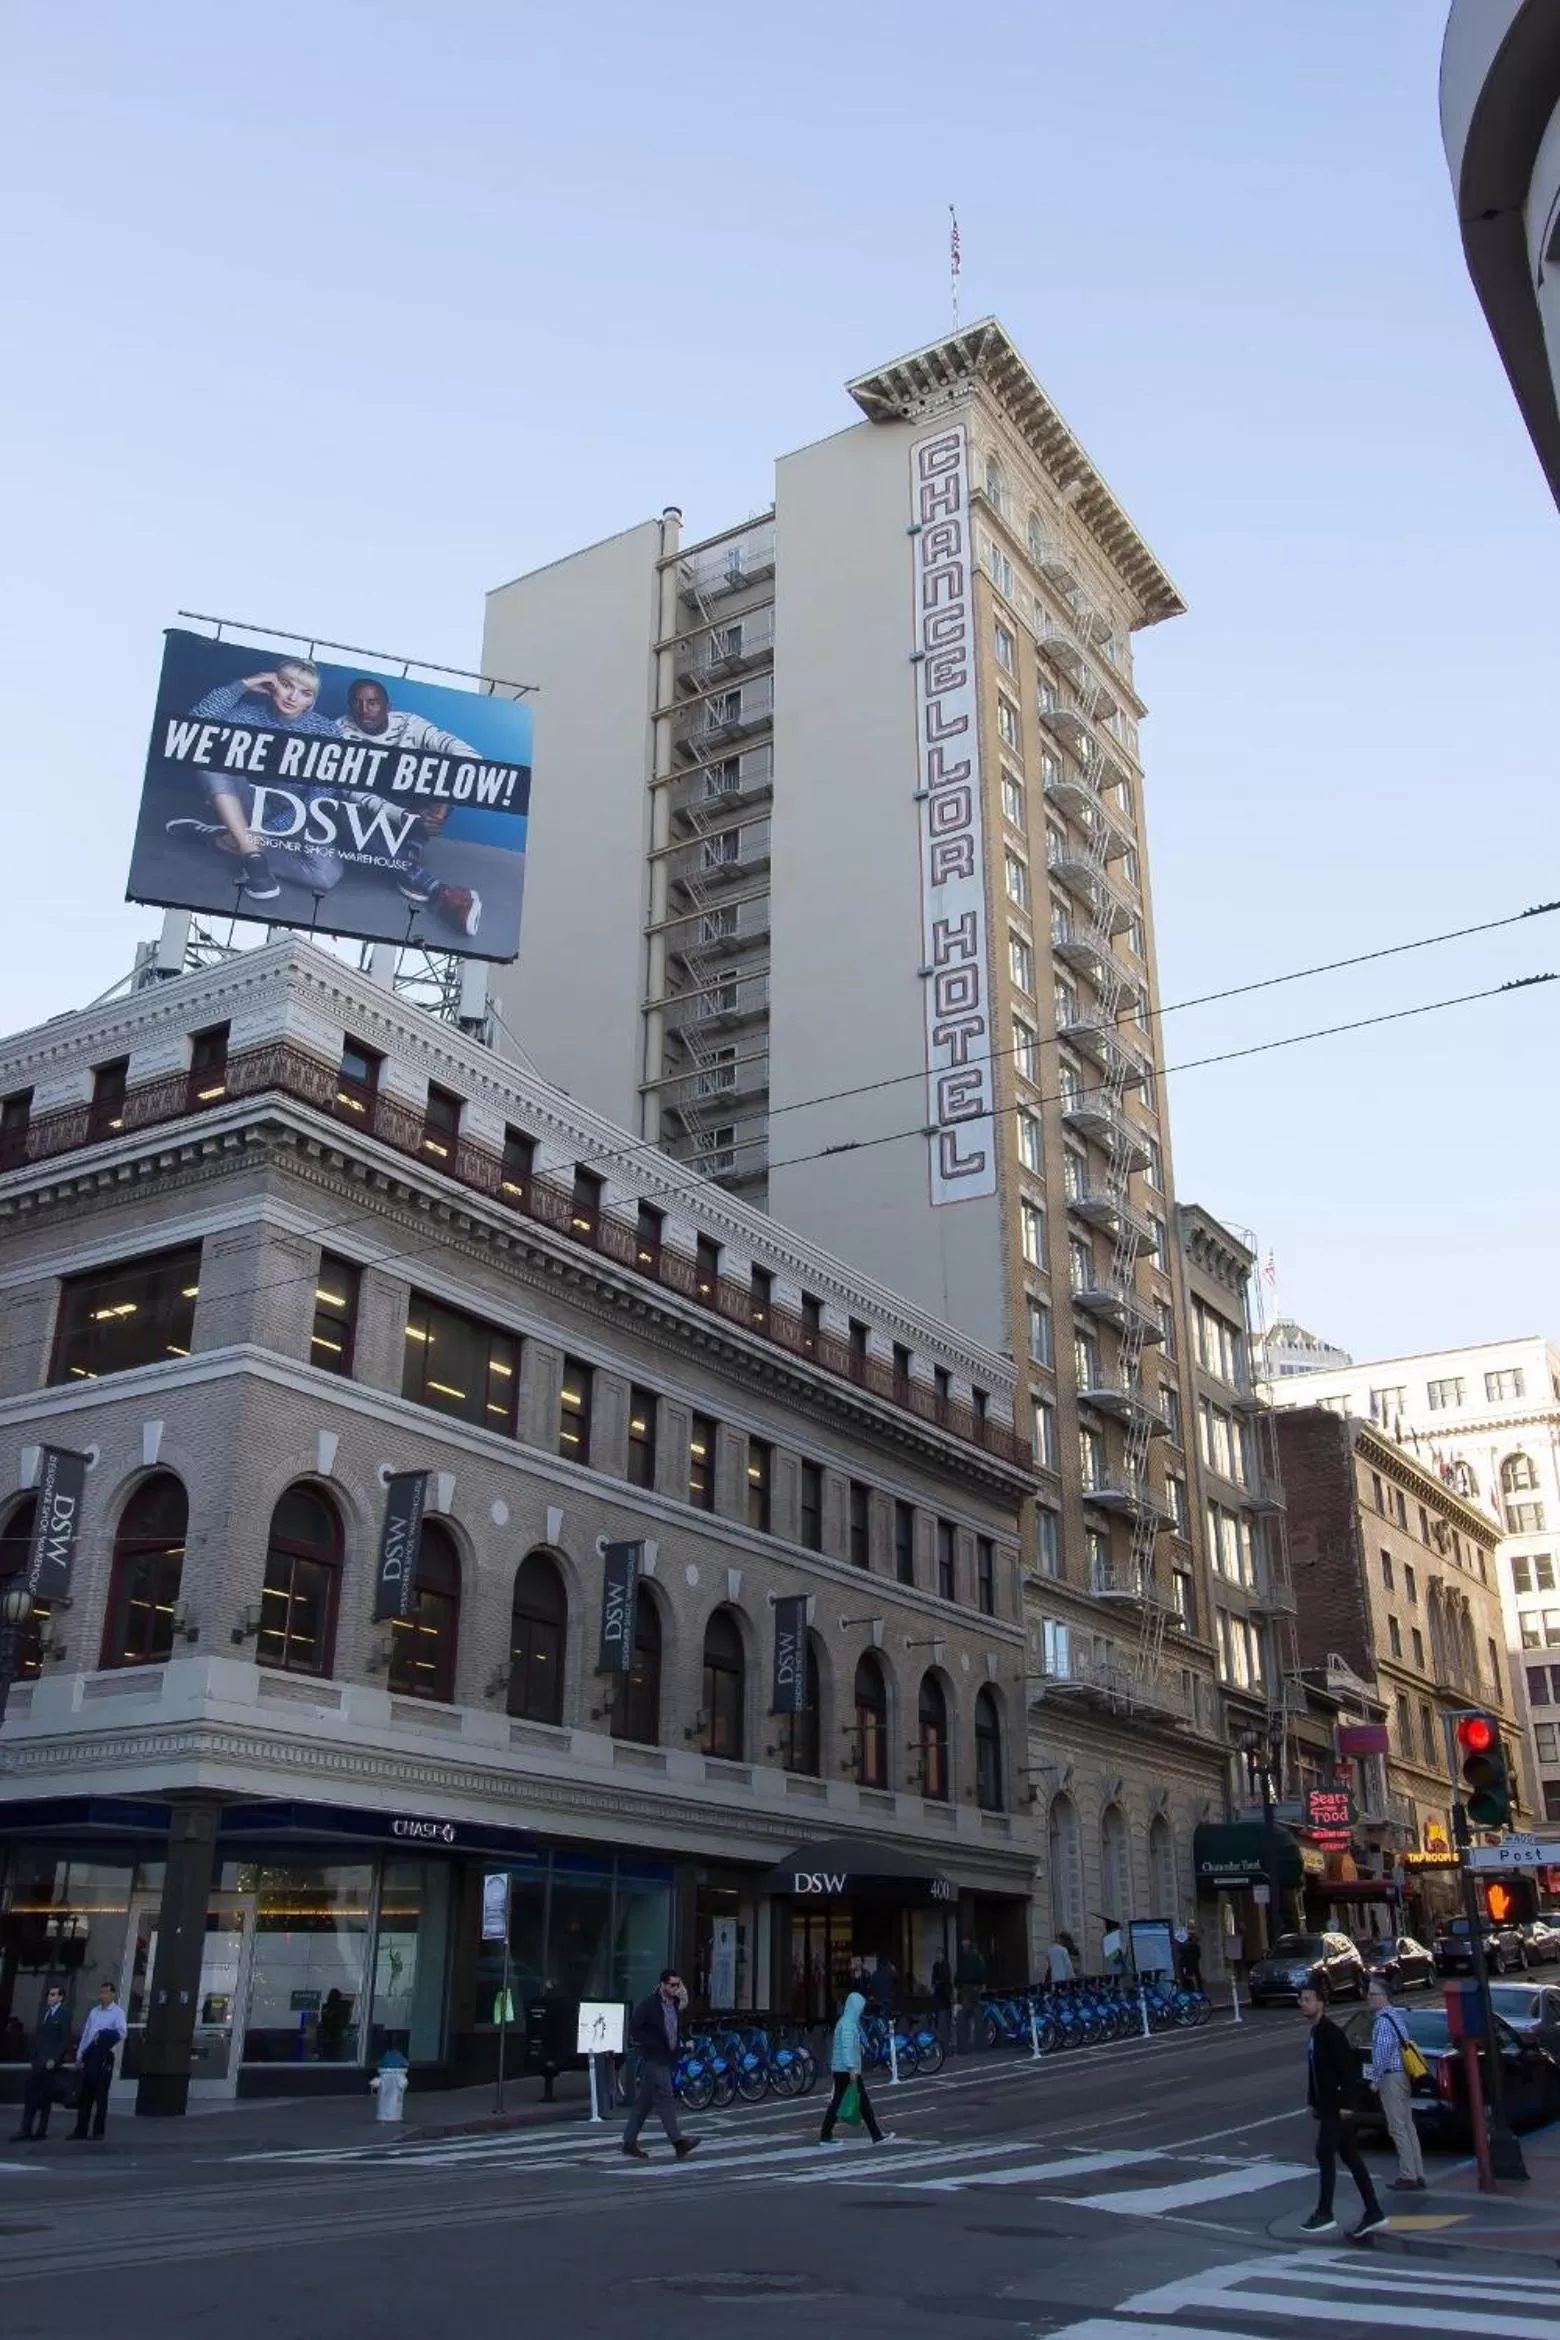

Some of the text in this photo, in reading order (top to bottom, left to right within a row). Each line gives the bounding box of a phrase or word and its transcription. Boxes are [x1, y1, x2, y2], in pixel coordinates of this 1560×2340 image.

[163, 718, 518, 806] WE'RE RIGHT BELOW!
[246, 783, 421, 858] DSW
[918, 432, 986, 1180] CHANCELLOR HOTEL
[247, 834, 411, 872] DESIGNER SHOE WAREHOUSE
[46, 1493, 75, 1569] DSW
[382, 1515, 408, 1582] DSW
[605, 1580, 625, 1641] DSW
[777, 1632, 795, 1685] DSW
[1310, 1789, 1349, 1806] Sears
[1310, 1805, 1349, 1824] Food
[392, 1819, 442, 1838] CHASE
[1499, 1847, 1543, 1862] Post
[793, 1872, 847, 1894] DSW
